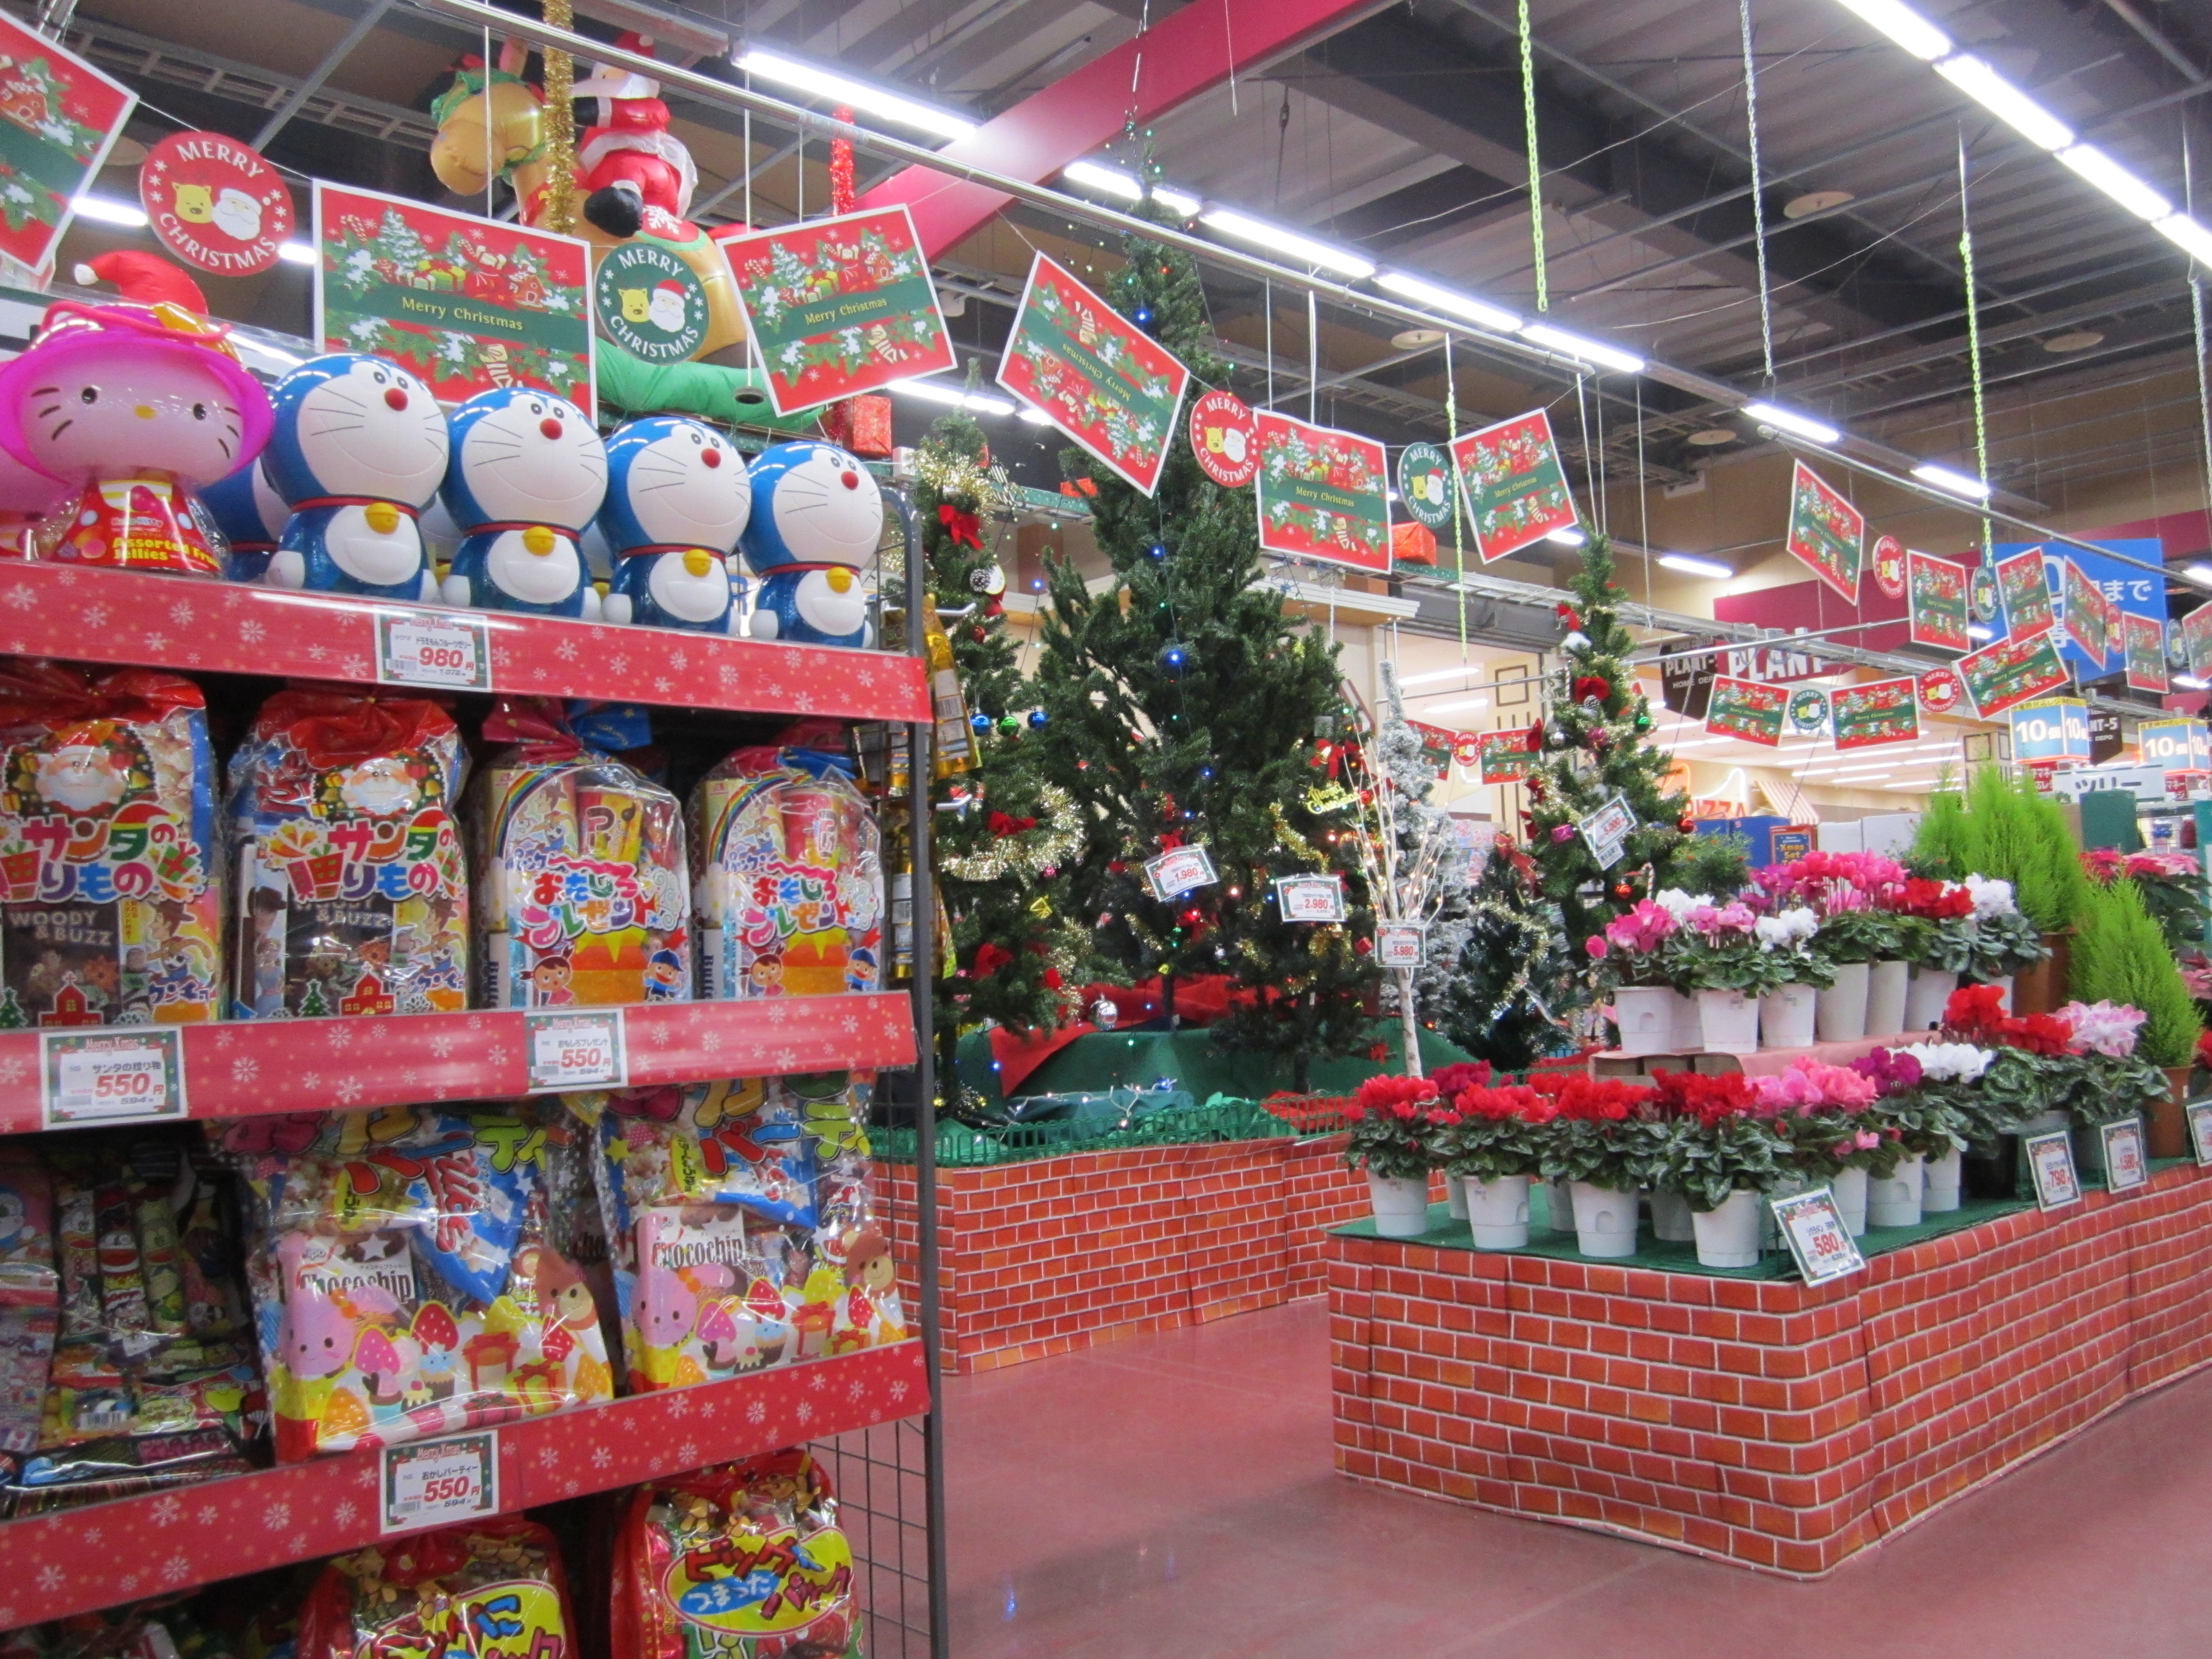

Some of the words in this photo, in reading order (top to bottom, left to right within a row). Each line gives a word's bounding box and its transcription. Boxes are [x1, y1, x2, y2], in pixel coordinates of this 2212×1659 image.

[176, 140, 265, 179] MERRY
[158, 211, 278, 271] CHRISTMAS
[617, 248, 684, 277] MERRY
[402, 296, 447, 320] Merry
[454, 307, 523, 331] Christmas
[804, 310, 836, 325] Merry
[840, 298, 887, 315] Christmas
[610, 314, 699, 359] CHRISTMAS
[1062, 343, 1102, 379] Christmas
[1105, 376, 1131, 402] Merry
[1206, 397, 1246, 421] MERRY
[1199, 447, 1254, 483] CHRISTMAS
[1409, 449, 1442, 466] MERRY
[1295, 486, 1318, 500] Merry
[1321, 490, 1355, 507] Christmas
[1495, 487, 1511, 499] Merry
[1512, 476, 1537, 492] Christmas
[1409, 495, 1451, 524] CHRISTMAS
[112, 538, 190, 555] Assorted
[114, 547, 168, 561] Jellies
[1880, 540, 1898, 554] MERRY
[1665, 654, 1715, 677] PLANT-
[1728, 646, 1824, 683] PLANT
[1672, 679, 1695, 689] HOME
[1698, 676, 1714, 685] DEP
[1924, 670, 1950, 683] MERRY
[1796, 691, 1819, 702] MERRY
[1923, 694, 1957, 712] CHRISTMAS
[1794, 714, 1826, 729] CHRISTMAS
[1458, 733, 1475, 741] MERRY
[1455, 754, 1478, 766] CHRISTMAS
[2075, 776, 2142, 793] ツリー
[20, 804, 177, 862] サンタの
[327, 811, 454, 863] サンタの
[534, 858, 639, 905] おもしろ
[751, 861, 838, 906] おもしろ
[10, 910, 98, 926] WOODY
[35, 925, 50, 940] &
[53, 926, 114, 946] BUZZ
